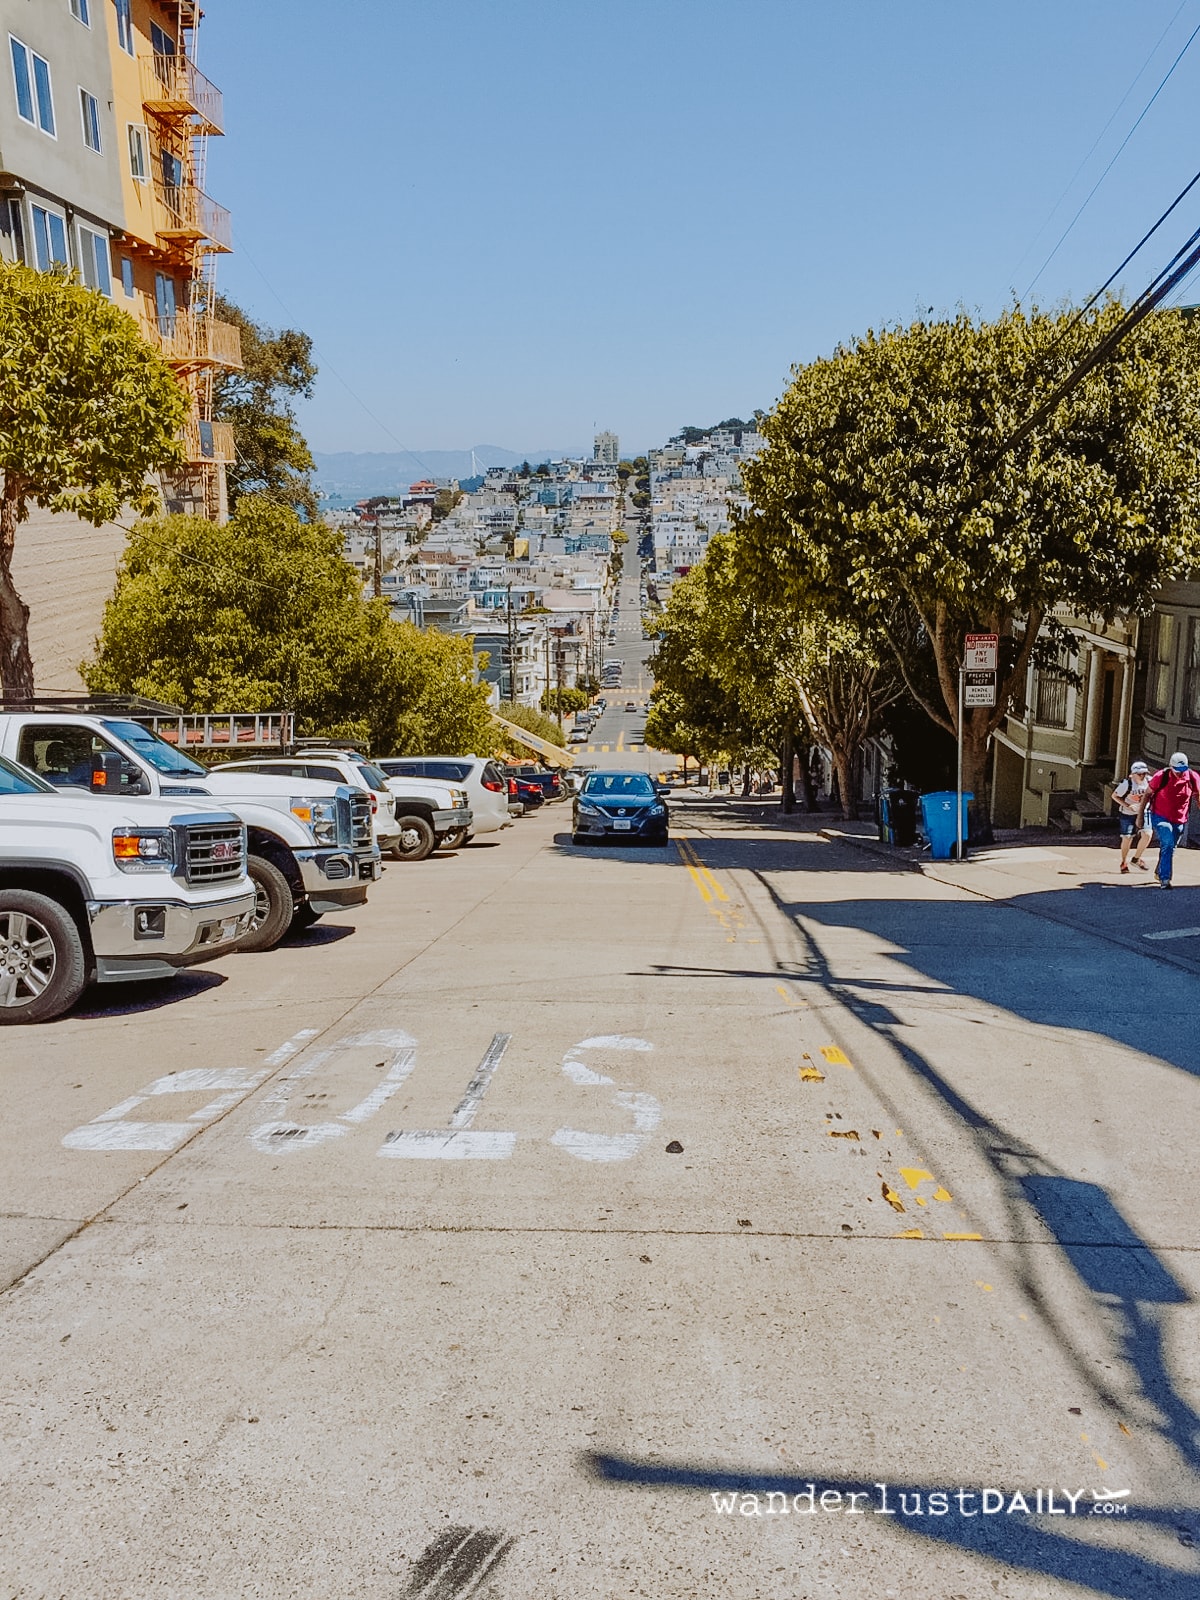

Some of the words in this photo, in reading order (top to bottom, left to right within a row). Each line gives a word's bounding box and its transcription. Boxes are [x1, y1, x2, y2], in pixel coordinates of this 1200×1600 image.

[967, 641, 975, 649] NO
[213, 840, 239, 859] GMC
[61, 1028, 663, 1162] STOP
